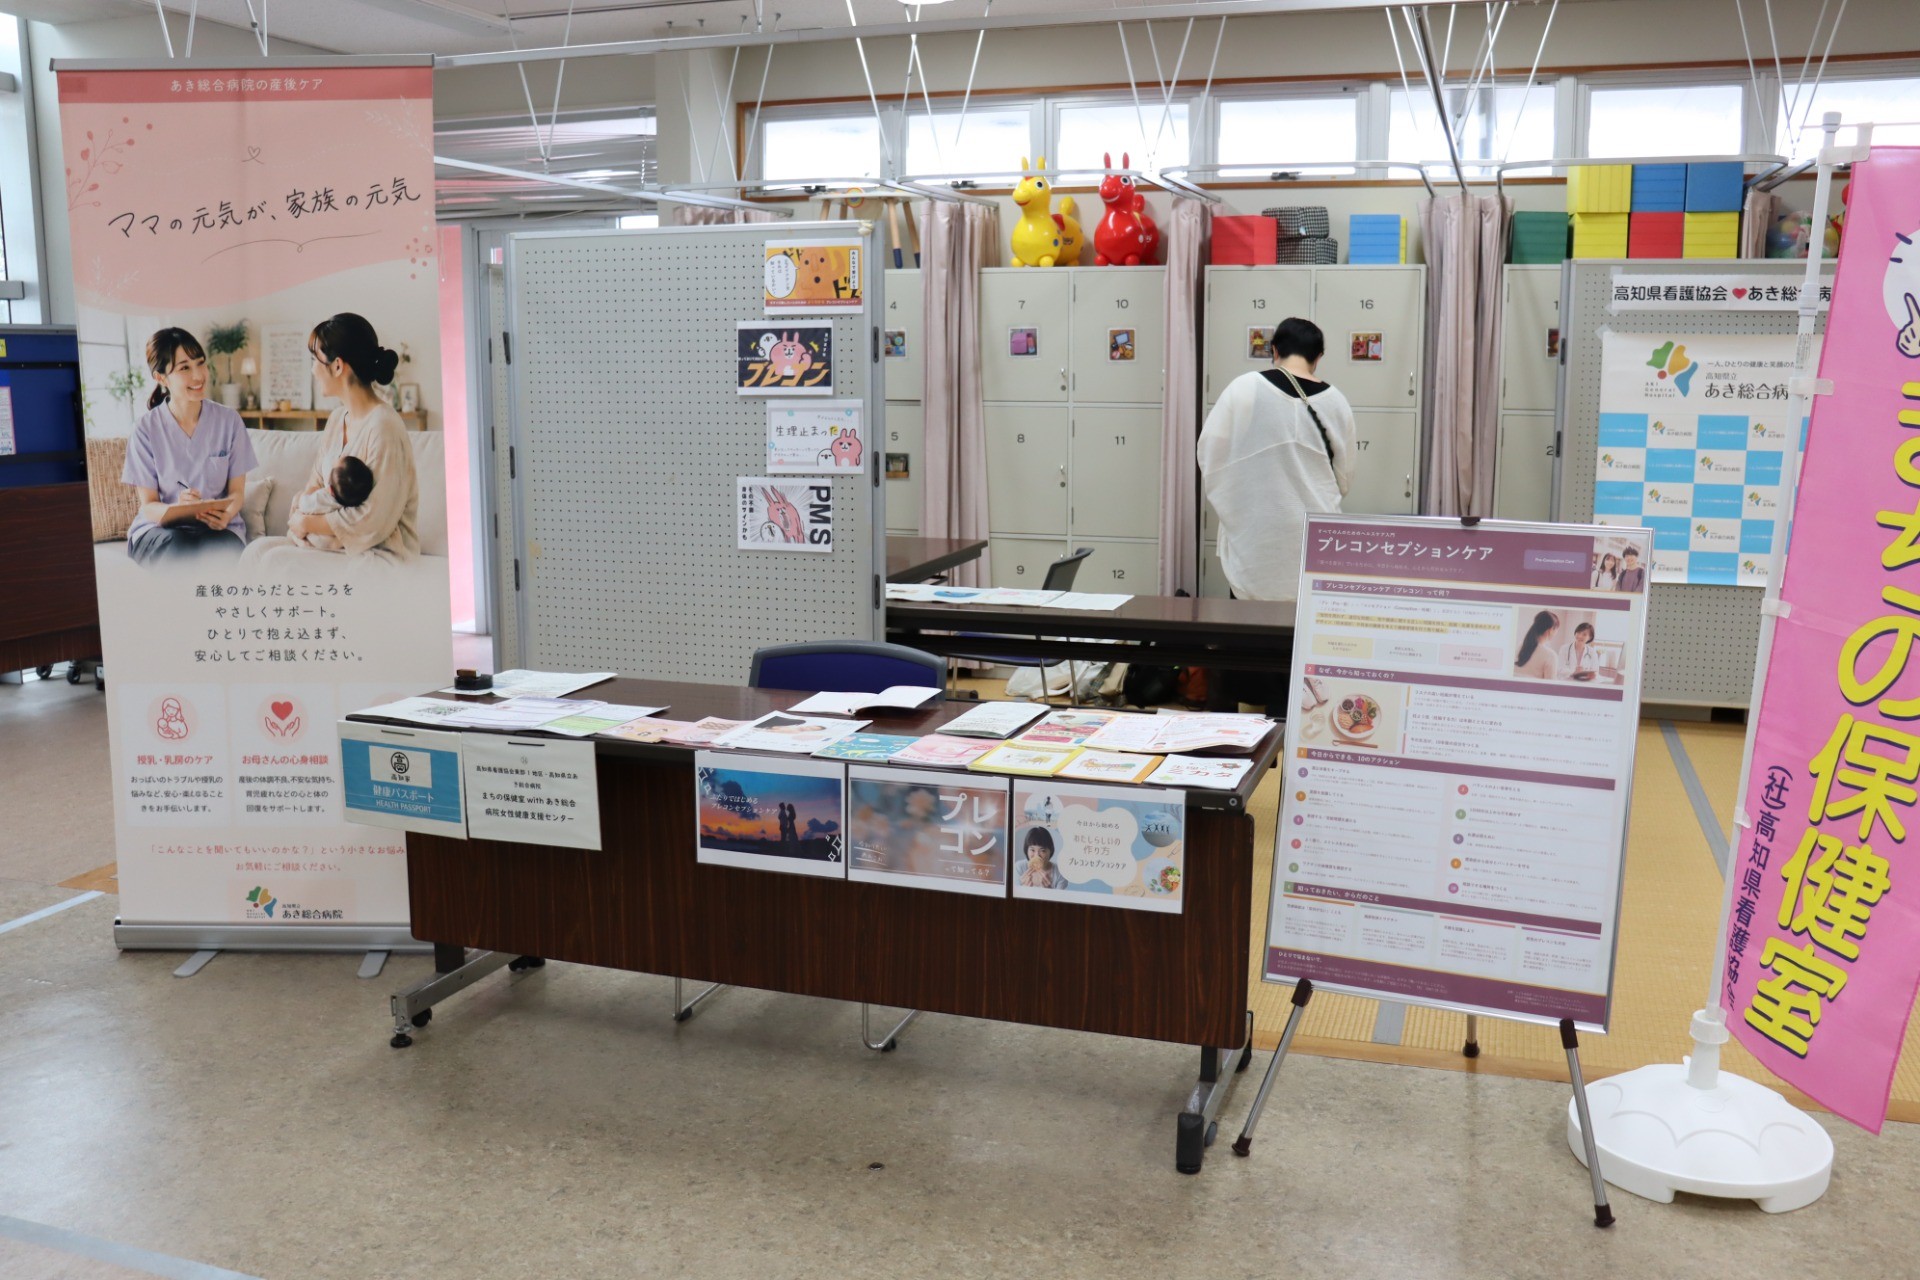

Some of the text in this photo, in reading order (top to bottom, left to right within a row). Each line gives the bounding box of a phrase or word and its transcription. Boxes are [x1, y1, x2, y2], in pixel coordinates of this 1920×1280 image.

[170, 78, 323, 93] あき総合病院の産後ケア
[1614, 286, 1832, 301] 高知県看護協会 あき総病
[890, 301, 897, 310] 4
[1018, 300, 1026, 309] 7
[1116, 300, 1128, 309] 10
[1252, 300, 1266, 309] 13
[1360, 300, 1374, 309] 16
[1553, 301, 1559, 310] 1
[1705, 372, 1738, 380] 高知県立
[1705, 383, 1800, 400] あき総合病
[775, 425, 838, 437] 生理止まった
[891, 432, 899, 441] 5
[1017, 434, 1025, 443] 8
[1115, 436, 1126, 445] 11
[1355, 441, 1369, 450] 17
[809, 485, 831, 545] PMS
[1318, 538, 1493, 561] プレコンセプションケア
[1016, 565, 1025, 575] 9
[1112, 569, 1125, 579] 12
[195, 584, 354, 598] 産後のからだとこころを
[215, 605, 338, 619] やさしくサポート。
[207, 627, 348, 641] ひとりで抱え込まず、
[194, 649, 363, 663] 安心してご相談ください。
[242, 755, 329, 765] お母さんの心身相談
[372, 785, 434, 803] 健康パスポート
[483, 792, 576, 808] まちの保健室 with あき総合
[376, 800, 431, 814] HEALTH PASSPORT
[939, 792, 998, 823] プレ
[485, 807, 574, 822] 病院女性健康支援センター
[940, 827, 997, 855] コン
[1083, 847, 1112, 857] 作り方
[235, 862, 342, 872] お気軽にご相談ください。
[1068, 858, 1127, 869] プレコンセプションケア
[282, 909, 343, 920] あき総合病院
